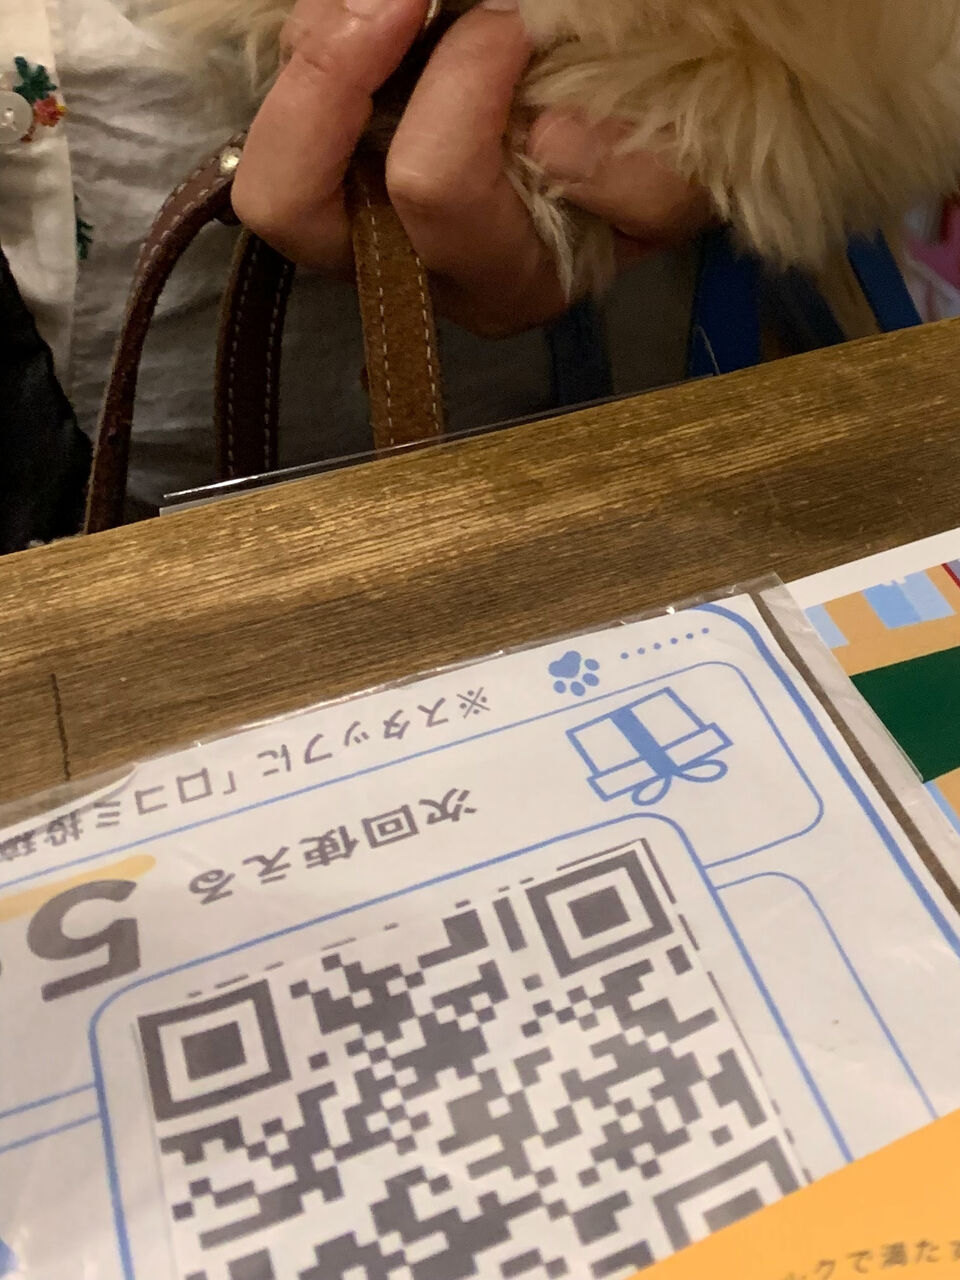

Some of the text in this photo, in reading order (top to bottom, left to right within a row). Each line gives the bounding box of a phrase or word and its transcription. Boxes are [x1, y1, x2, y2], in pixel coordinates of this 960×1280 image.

[189, 789, 477, 905] 次回使える
